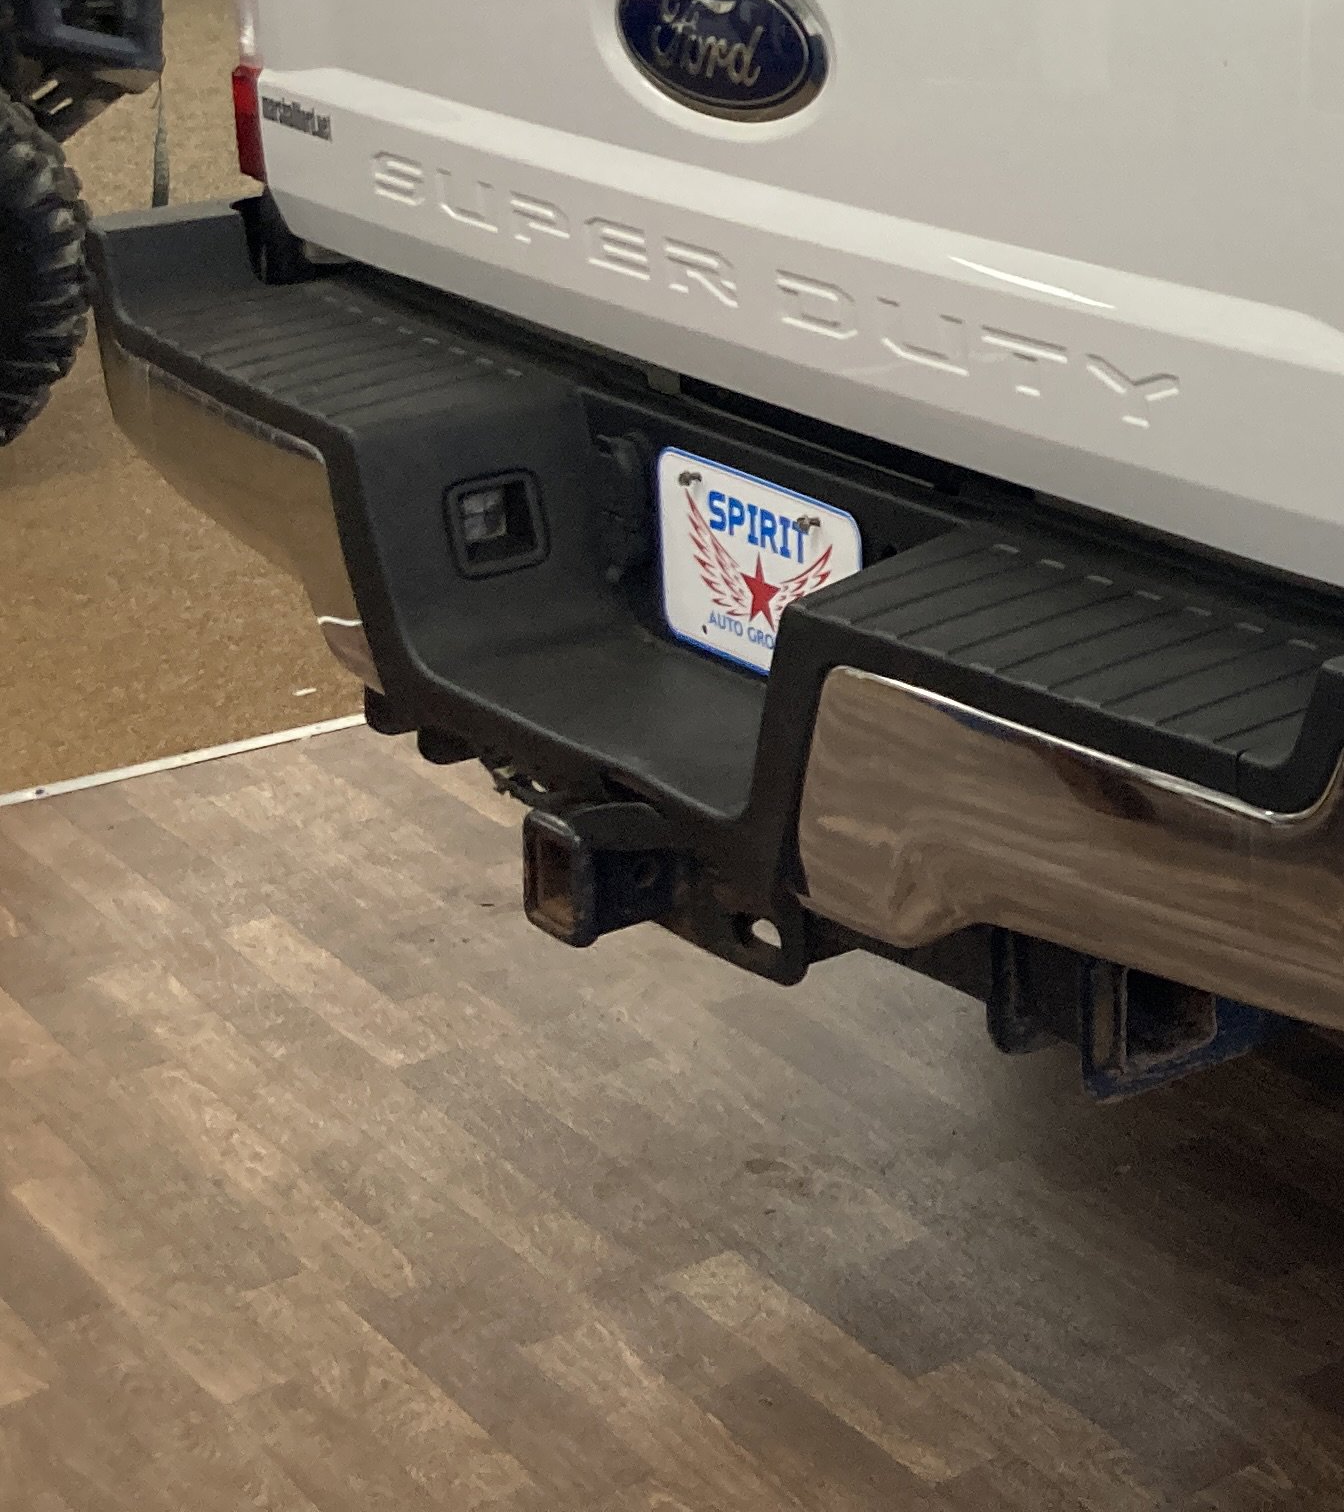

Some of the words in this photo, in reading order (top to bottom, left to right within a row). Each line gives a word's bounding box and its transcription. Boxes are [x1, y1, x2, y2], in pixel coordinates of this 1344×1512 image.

[371, 149, 739, 309] SUPER
[774, 267, 1182, 429] DUTY
[707, 489, 809, 565] SPIRIT
[709, 609, 744, 638] AUTO
[747, 625, 776, 651] GRO
